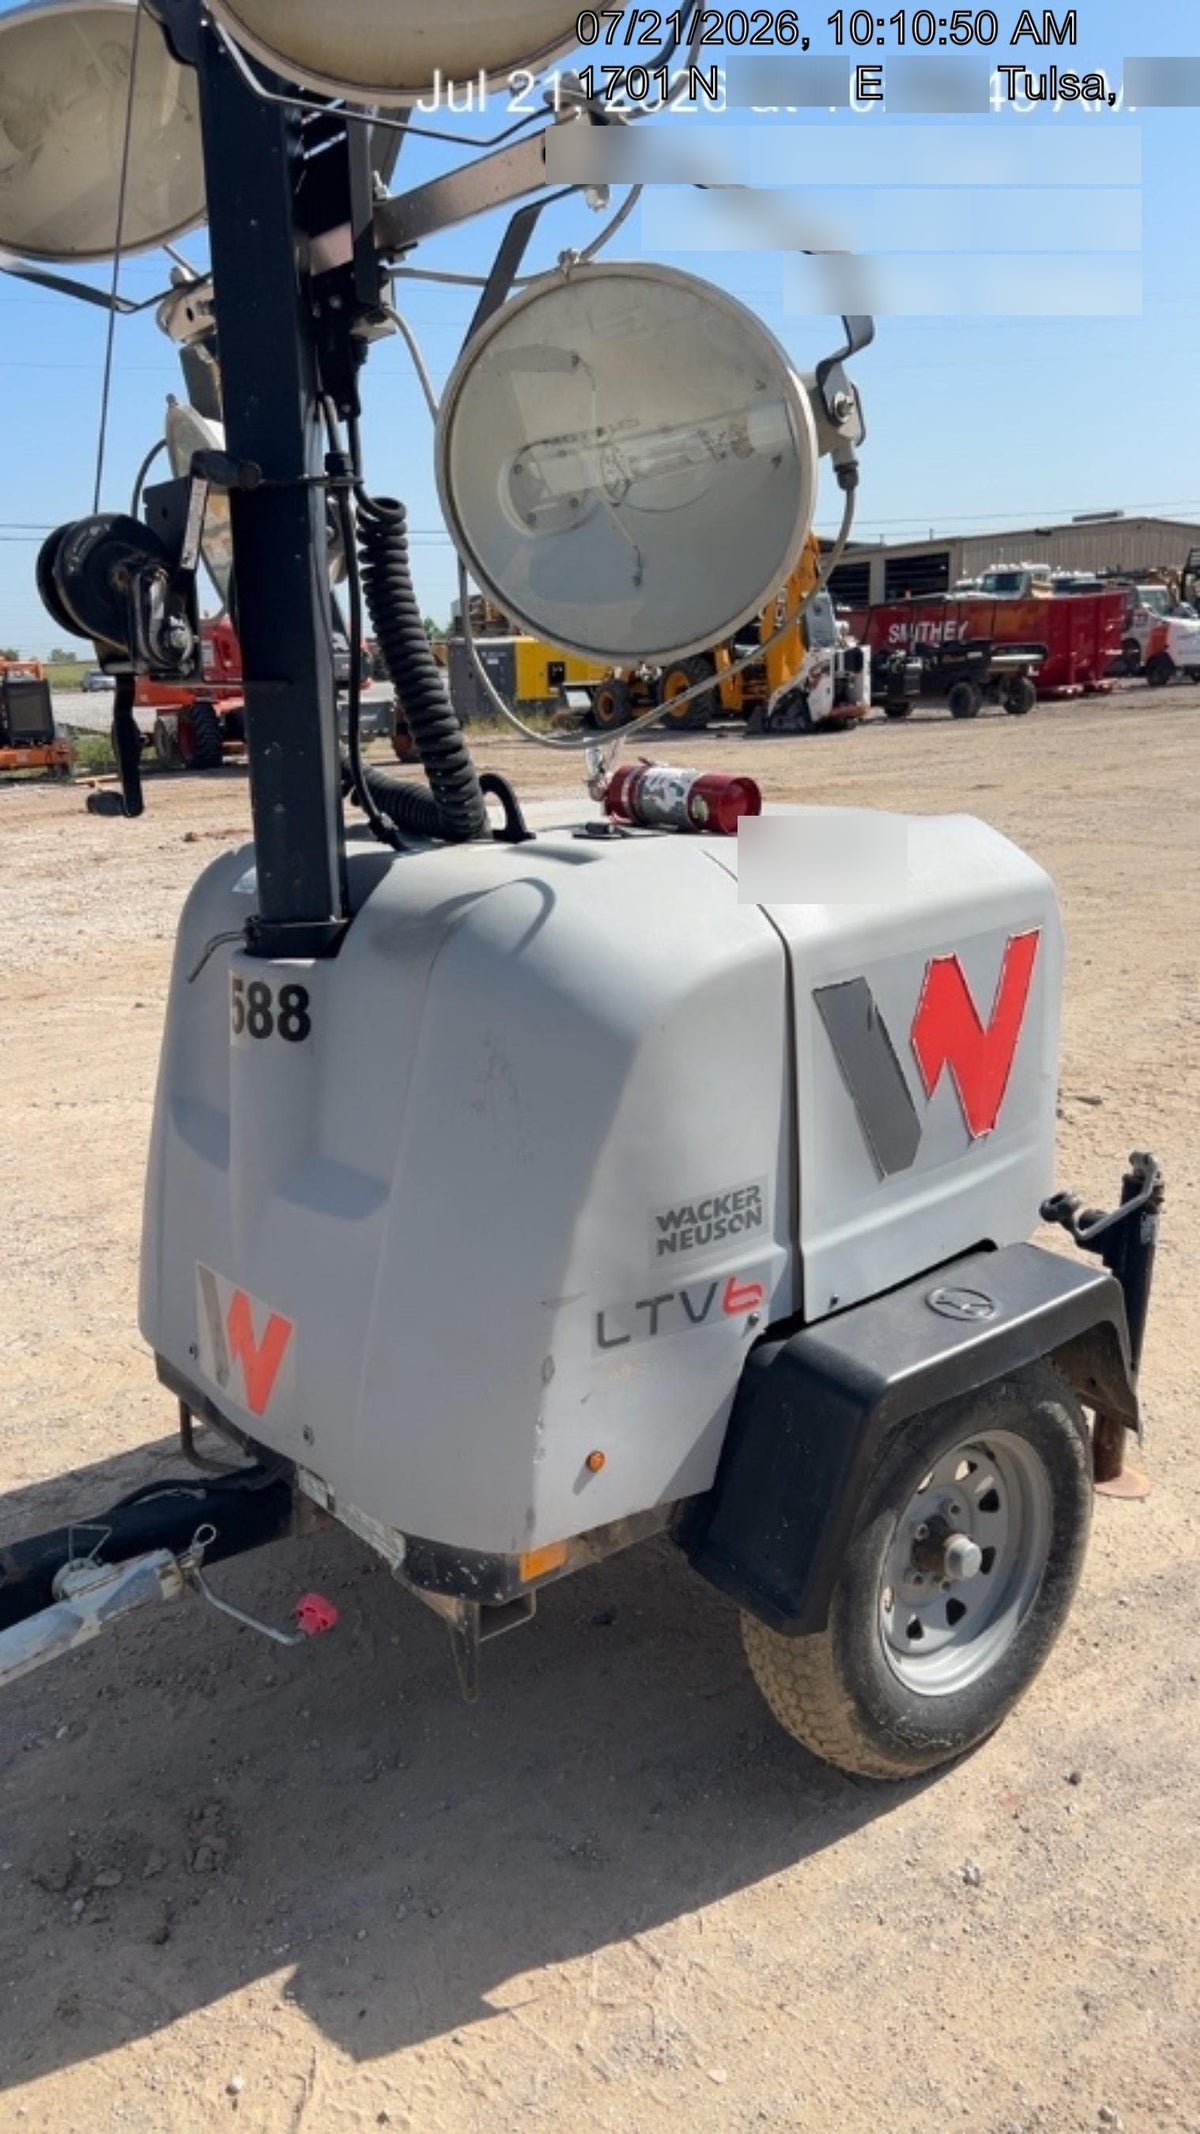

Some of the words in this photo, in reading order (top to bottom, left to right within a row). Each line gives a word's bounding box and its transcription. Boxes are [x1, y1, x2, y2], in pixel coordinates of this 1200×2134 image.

[656, 1185, 762, 1232] WACKER
[657, 1206, 762, 1256] NEUSON
[596, 1275, 765, 1350] LTV6
